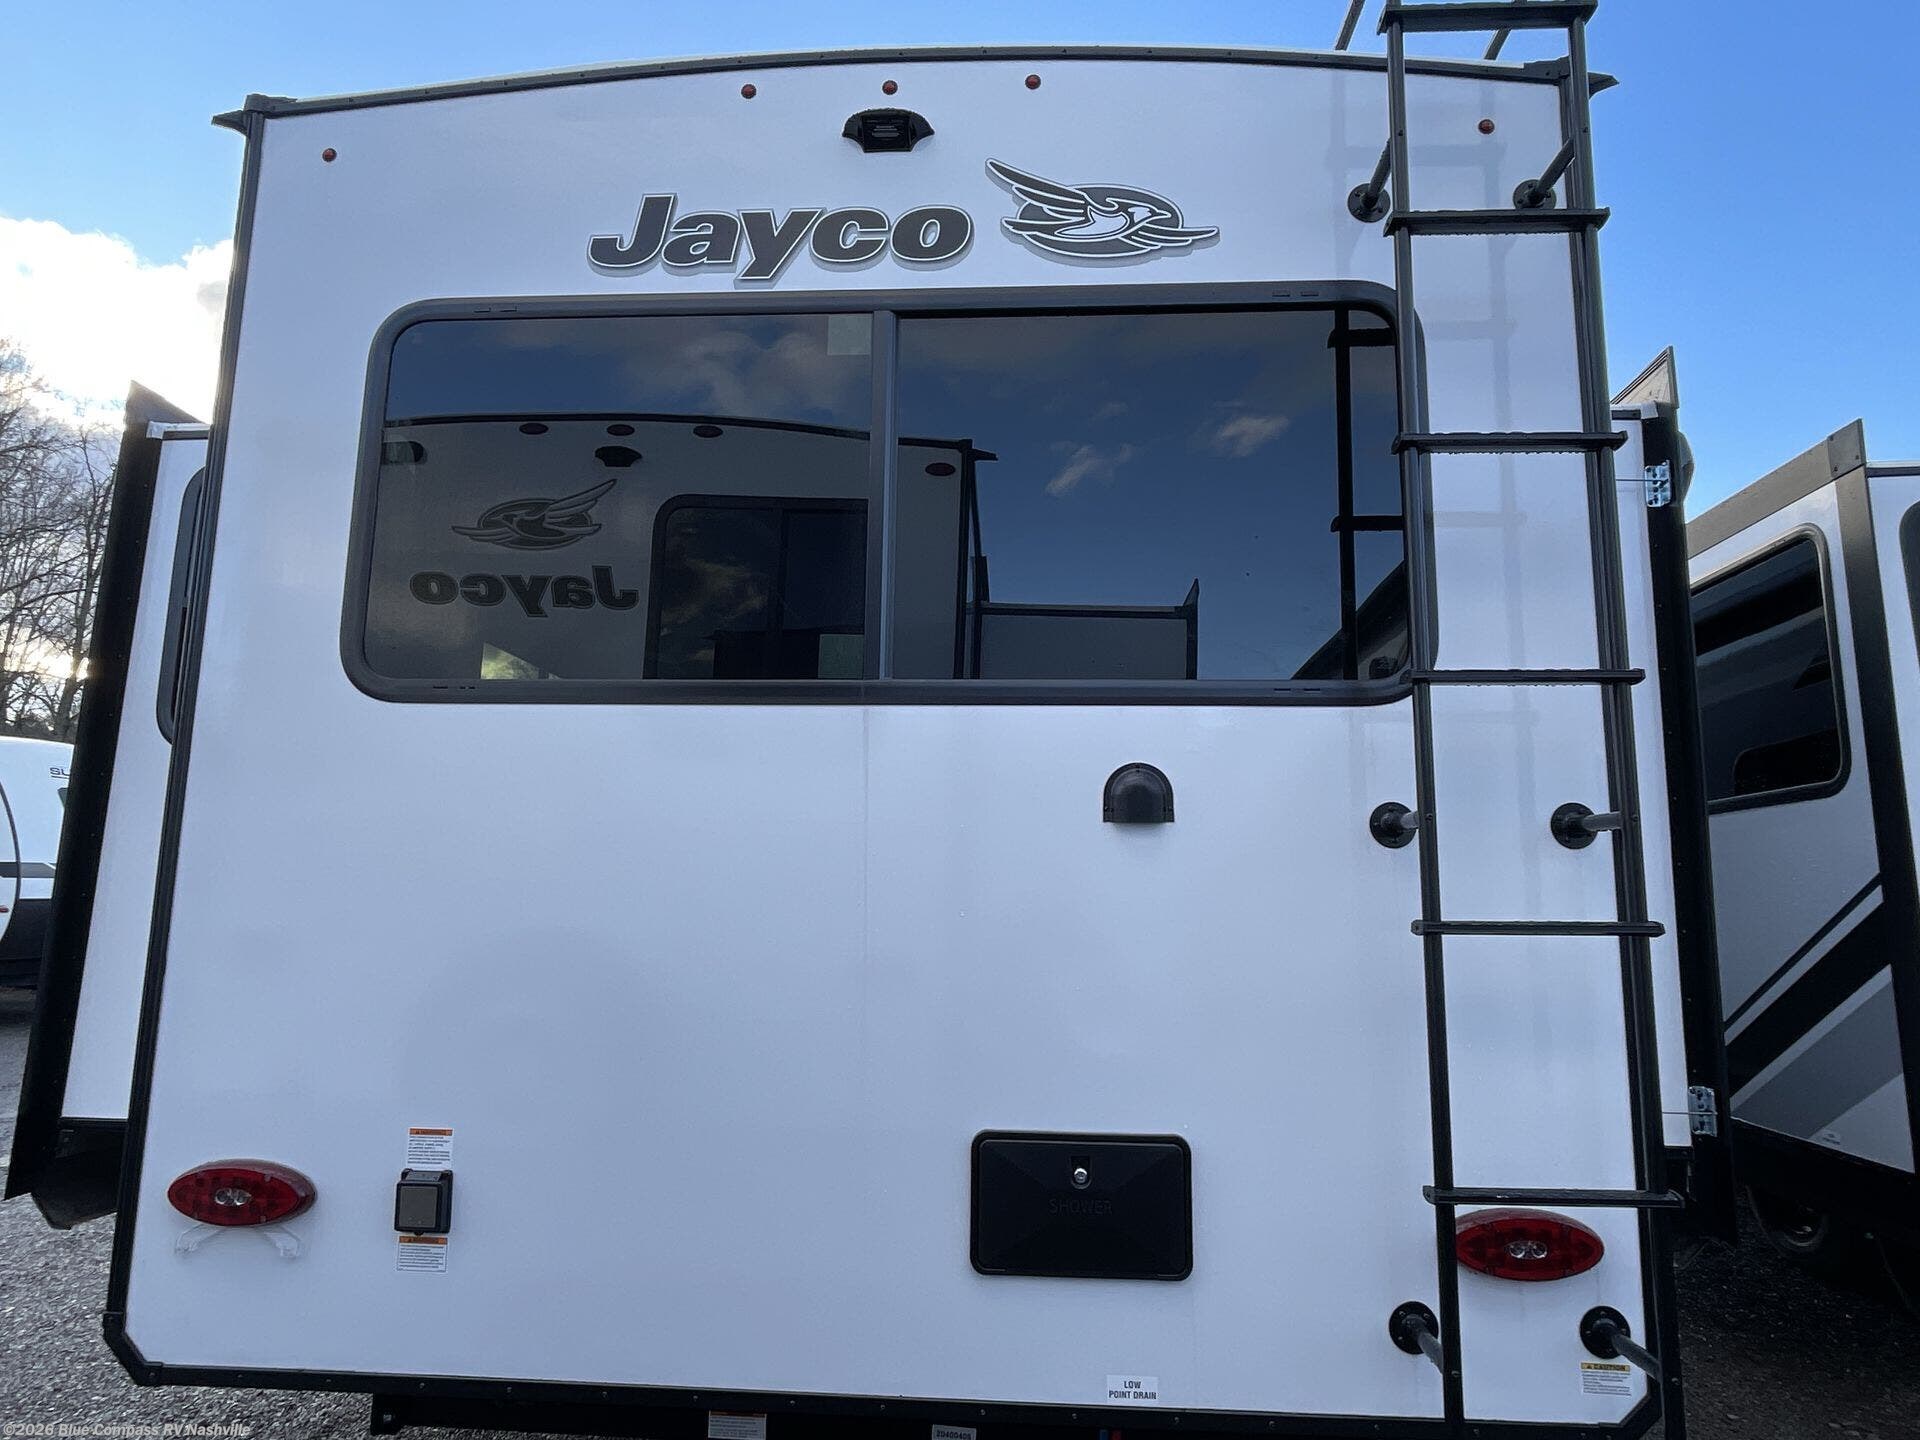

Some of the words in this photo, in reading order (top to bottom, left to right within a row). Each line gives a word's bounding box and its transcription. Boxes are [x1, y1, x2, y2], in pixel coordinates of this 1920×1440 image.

[588, 192, 974, 281] Jayco
[1048, 1198, 1113, 1216] SHOWER
[1123, 1380, 1142, 1389] LOW
[1108, 1390, 1131, 1399] POINT
[1133, 1391, 1157, 1400] DRAIN
